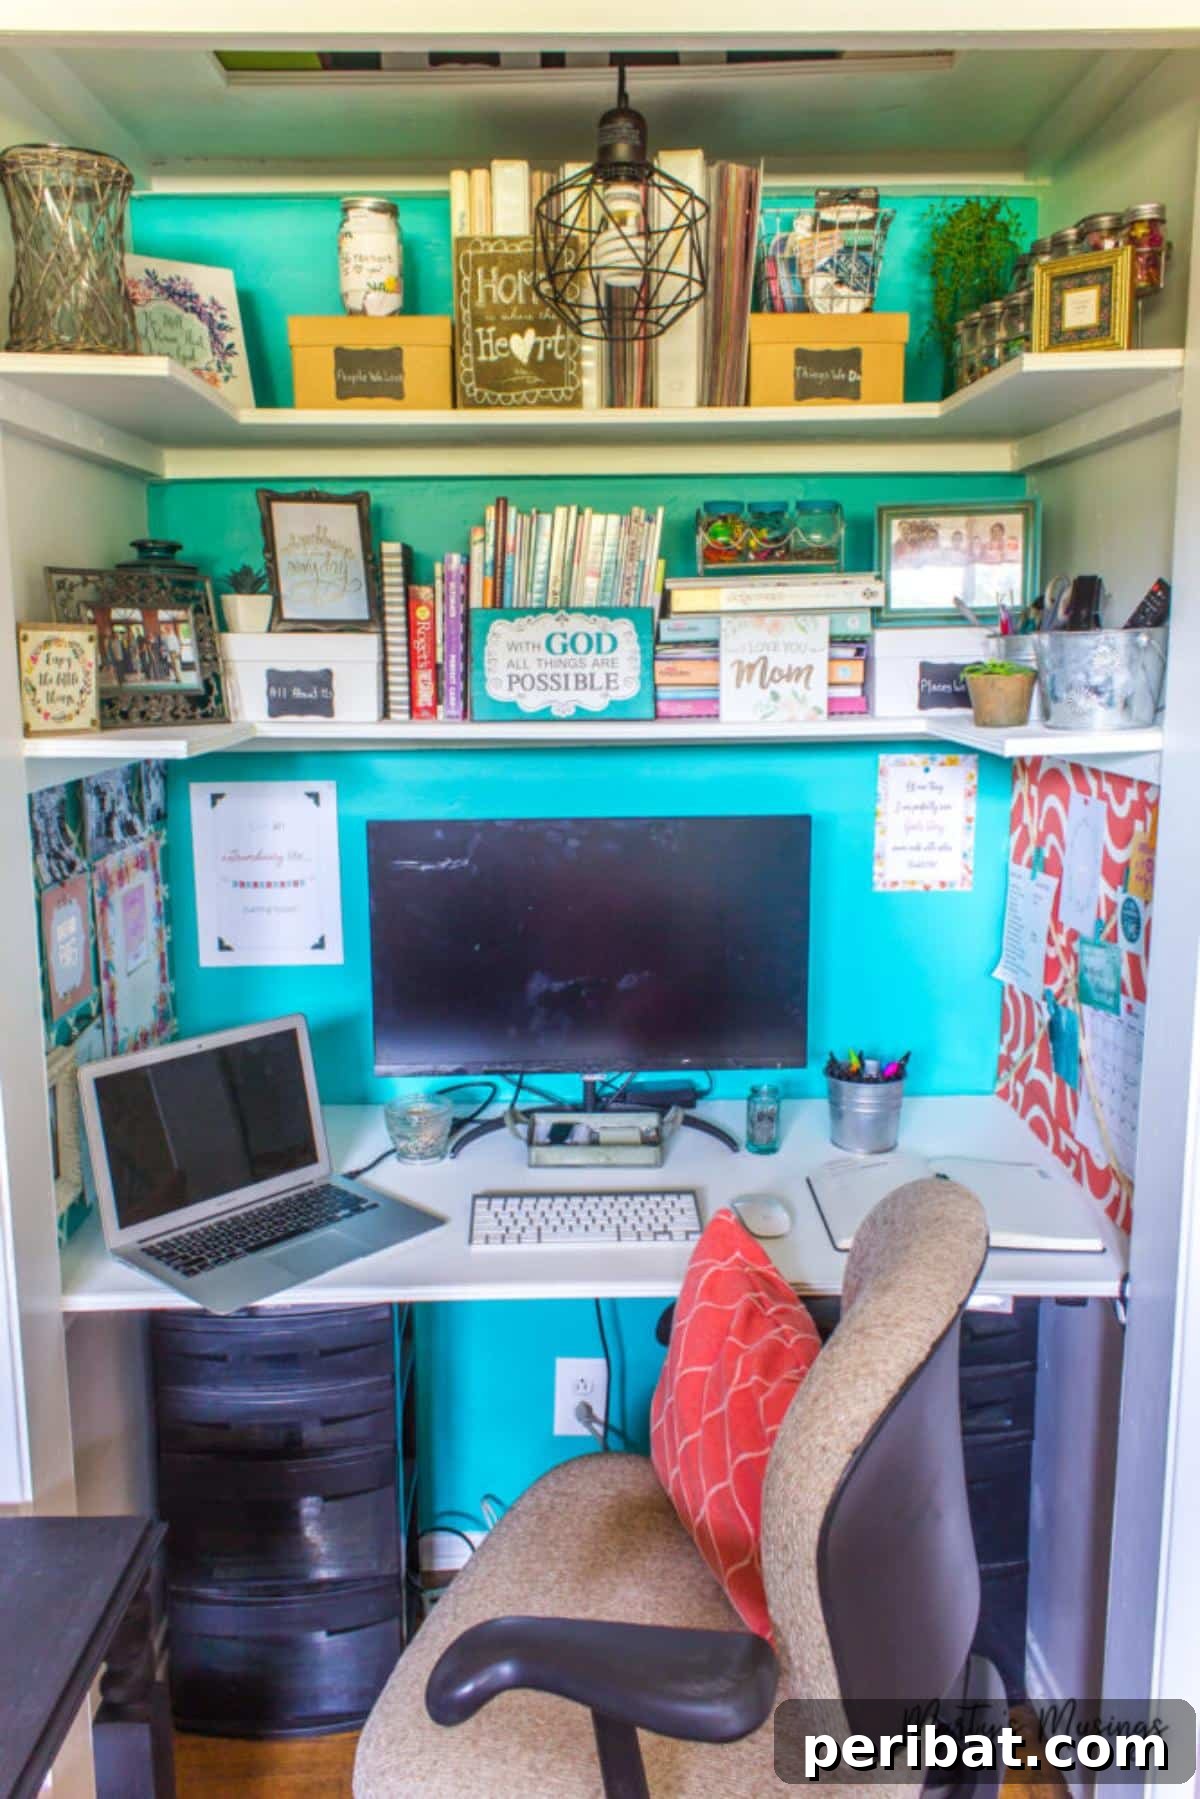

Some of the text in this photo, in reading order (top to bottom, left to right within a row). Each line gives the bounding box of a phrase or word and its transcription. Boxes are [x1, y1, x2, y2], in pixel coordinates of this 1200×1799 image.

[506, 631, 619, 656] WITH GOD
[506, 657, 620, 669] ALL THINGS ARE
[730, 656, 814, 690] Mom
[507, 673, 620, 692] POSSIBLE
